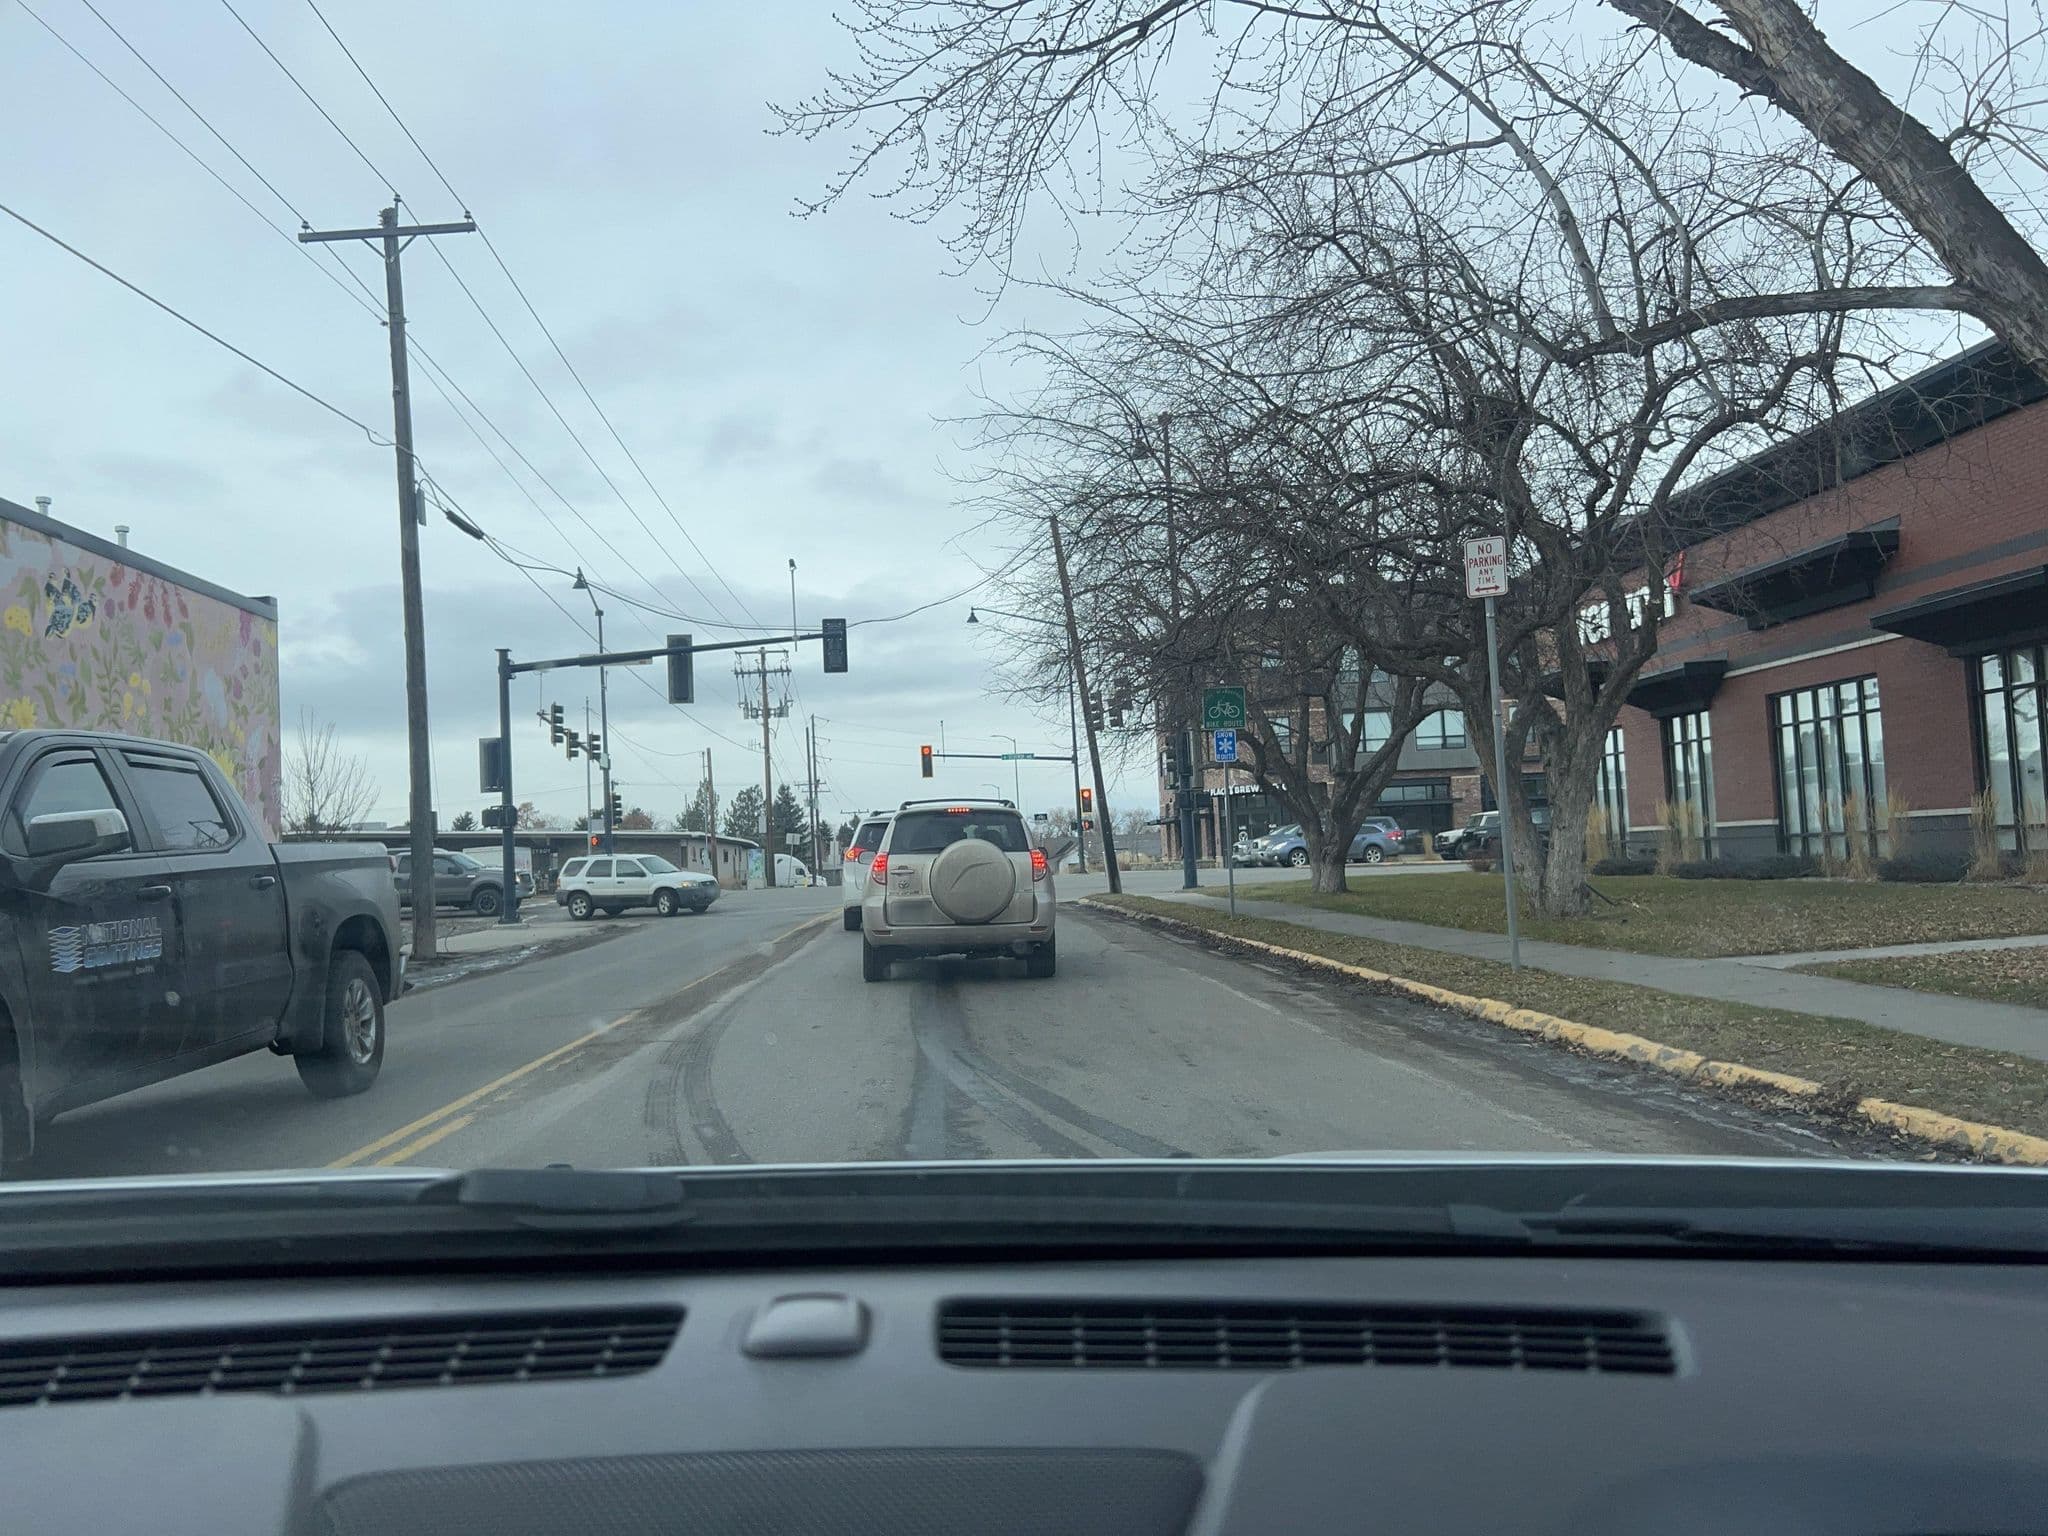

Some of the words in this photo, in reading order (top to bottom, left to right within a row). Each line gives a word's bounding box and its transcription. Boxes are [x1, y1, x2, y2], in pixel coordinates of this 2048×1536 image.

[1478, 543, 1492, 555] NO
[1469, 555, 1502, 568] PARKING
[1478, 568, 1494, 576] ANY
[1478, 576, 1496, 584] TIME
[1223, 719, 1243, 727] ROUTE
[81, 916, 162, 946] NATIONAL
